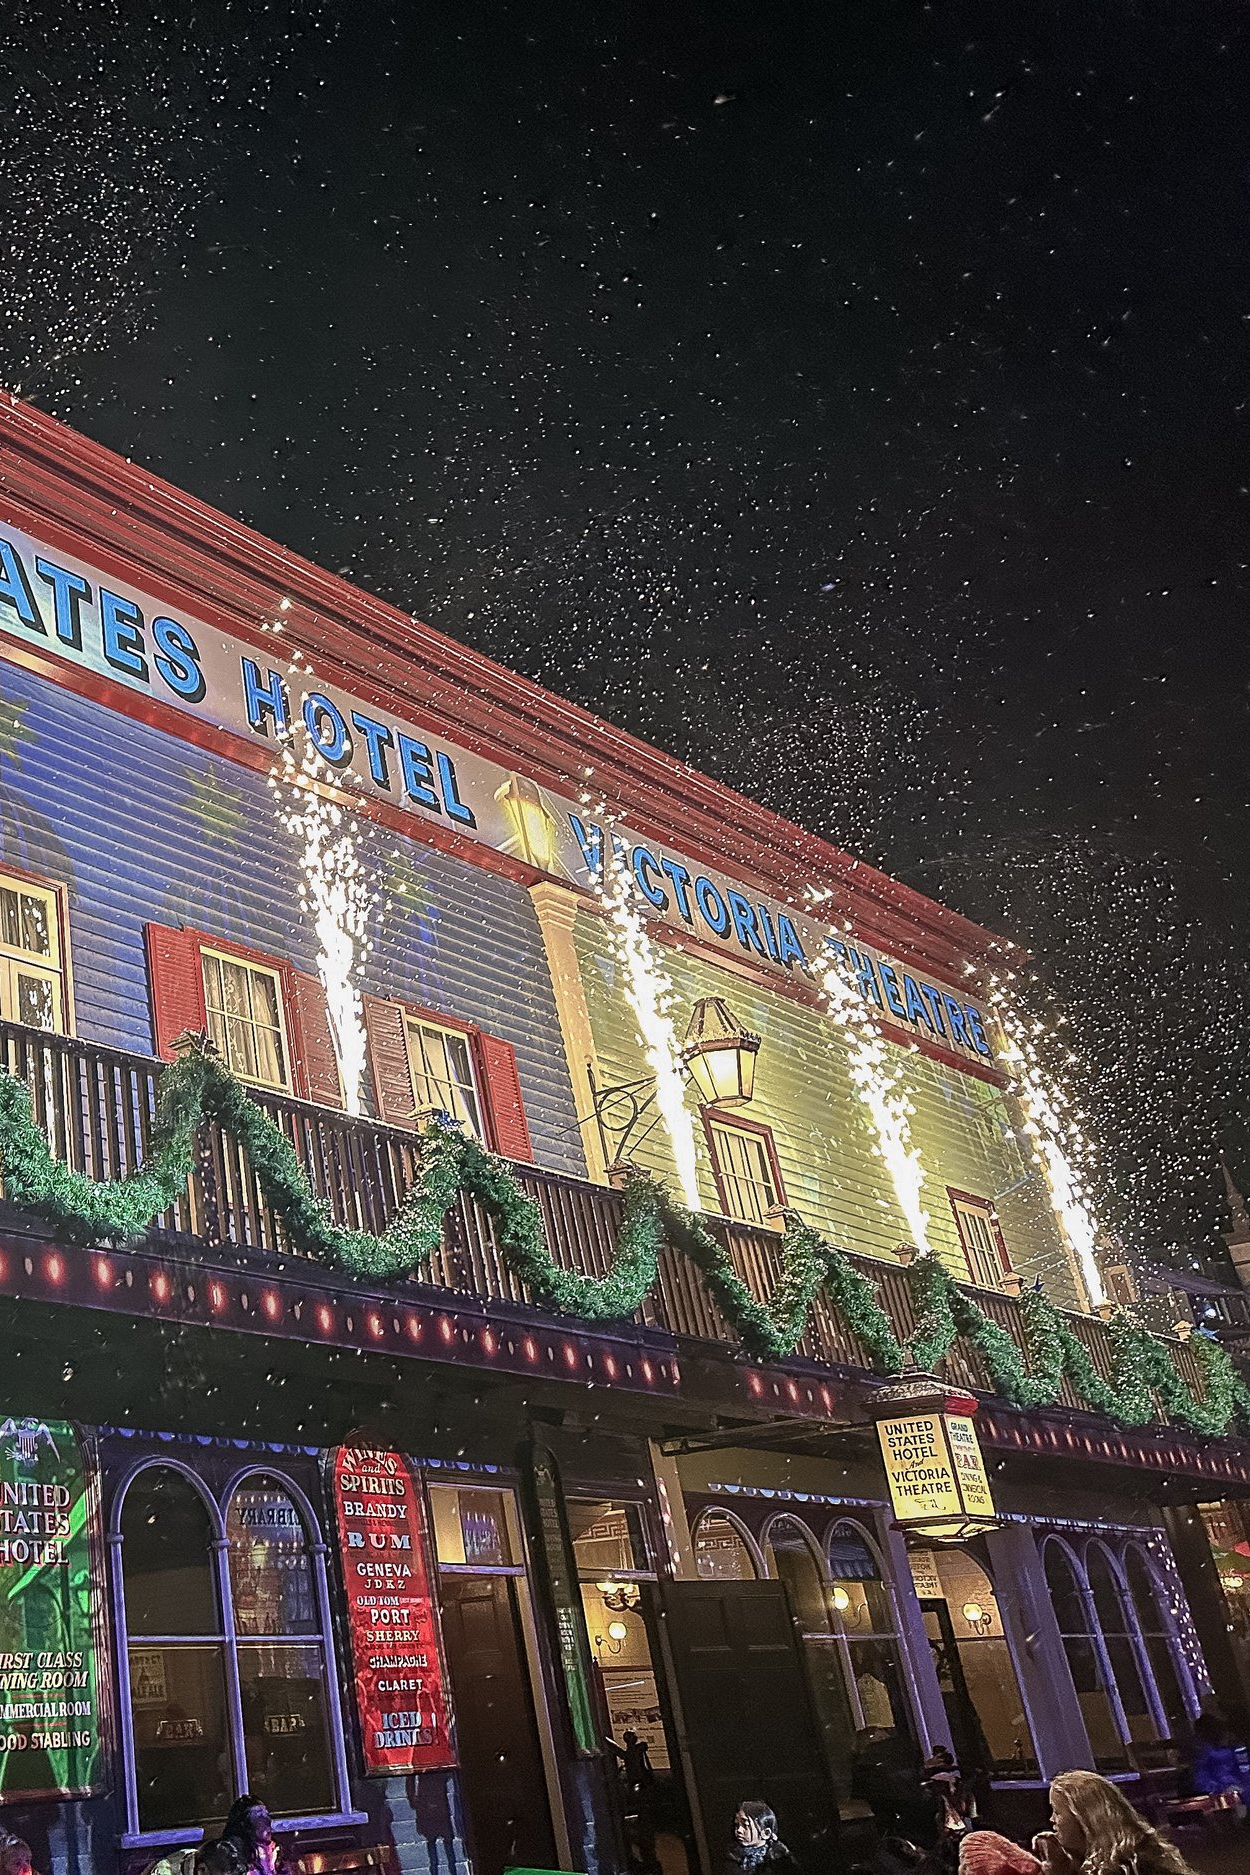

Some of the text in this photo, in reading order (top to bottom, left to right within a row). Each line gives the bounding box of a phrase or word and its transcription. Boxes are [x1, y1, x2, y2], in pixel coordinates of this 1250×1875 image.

[241, 656, 478, 830] HOTEL
[568, 812, 817, 981] VICTORIA
[823, 934, 994, 1061] THEATRE
[884, 1420, 934, 1436] UNITED
[888, 1433, 935, 1448] STATES
[892, 1446, 938, 1461] HOTEL
[954, 1452, 981, 1471] BAR
[342, 1448, 397, 1476] WINES
[361, 1463, 381, 1474] and
[905, 1458, 925, 1470] And
[891, 1467, 950, 1483] VICTORIA
[340, 1474, 406, 1497] SPIRITS
[895, 1482, 952, 1497] THEATRE
[343, 1501, 408, 1519] BRANDY
[347, 1532, 412, 1550] RUM
[357, 1562, 412, 1578] GENEVA
[356, 1595, 377, 1607] OLD
[378, 1595, 400, 1607] TOM
[370, 1608, 410, 1626] PORT
[366, 1630, 420, 1643] SHERRY
[36, 1651, 84, 1670] CLASS
[368, 1654, 428, 1669] CHAMPAGNE
[40, 1670, 89, 1691] ROOM
[378, 1679, 423, 1692] CLARET
[57, 1701, 91, 1717] ROOM
[381, 1711, 422, 1730] ICED
[30, 1729, 91, 1750] STABLING
